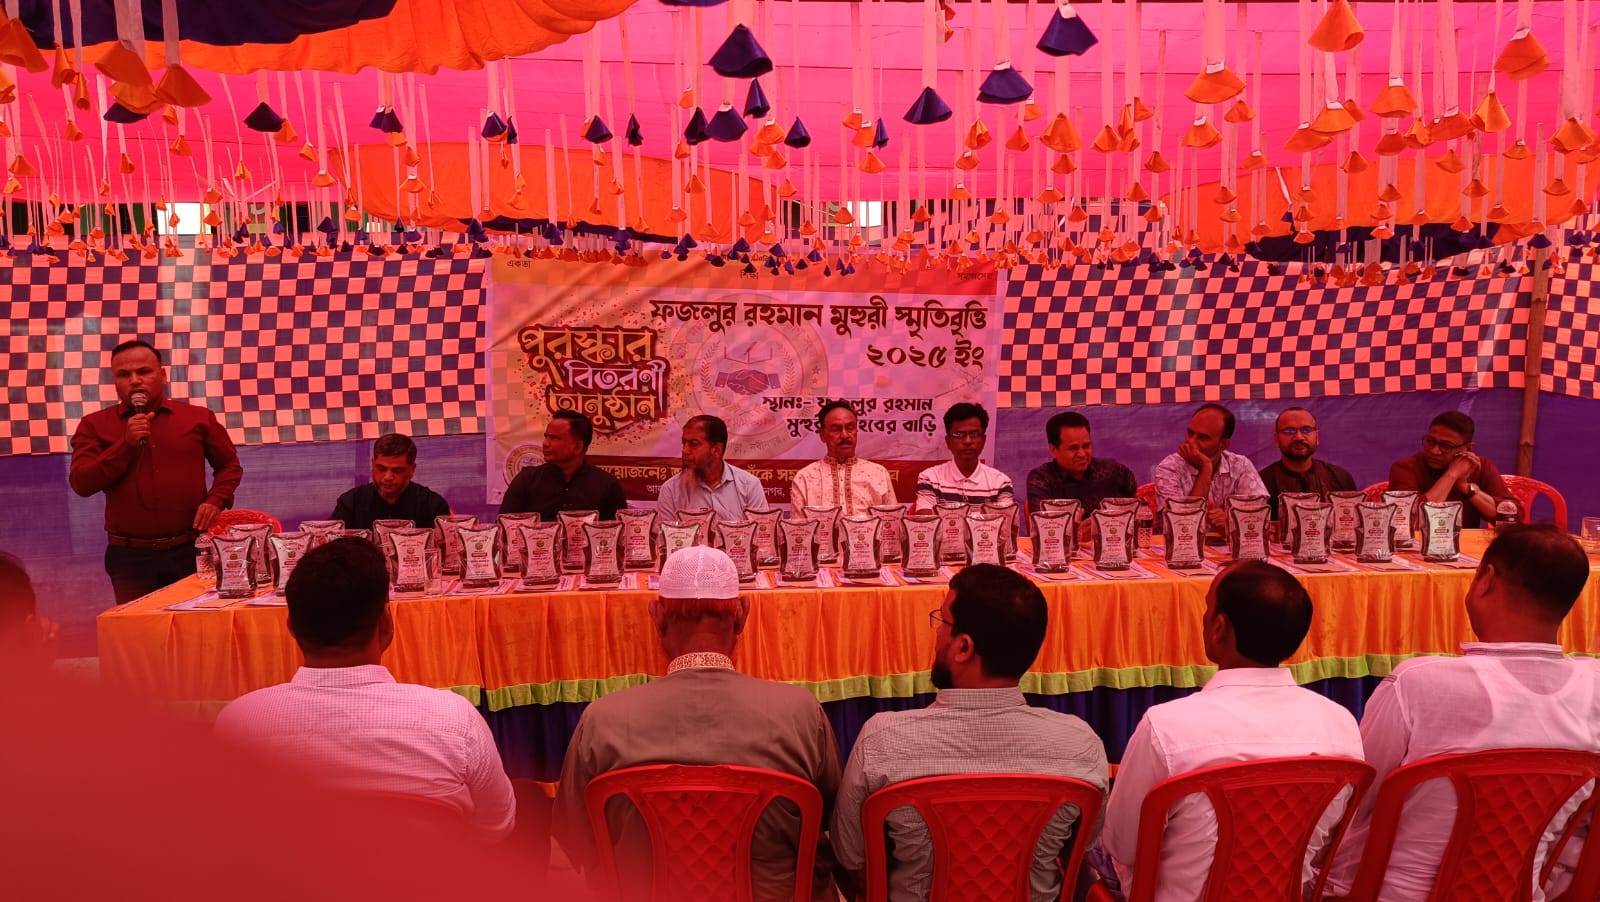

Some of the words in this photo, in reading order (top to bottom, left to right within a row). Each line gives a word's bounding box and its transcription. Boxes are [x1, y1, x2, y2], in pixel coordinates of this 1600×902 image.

[506, 260, 531, 268] একতা
[649, 300, 738, 336] ফজলুর
[744, 303, 823, 327] রহমান
[829, 295, 888, 338] মুহুরী
[895, 299, 988, 340] স্মৃতিবৃত্তি
[519, 325, 656, 388] পুরস্কার
[866, 344, 948, 369] ২০২৫
[954, 339, 985, 370] ইং
[563, 359, 667, 414] বিতরণী
[548, 388, 657, 428] অনুষ্ঠান
[882, 398, 934, 414] রহমান
[902, 412, 937, 436] বাড়ি
